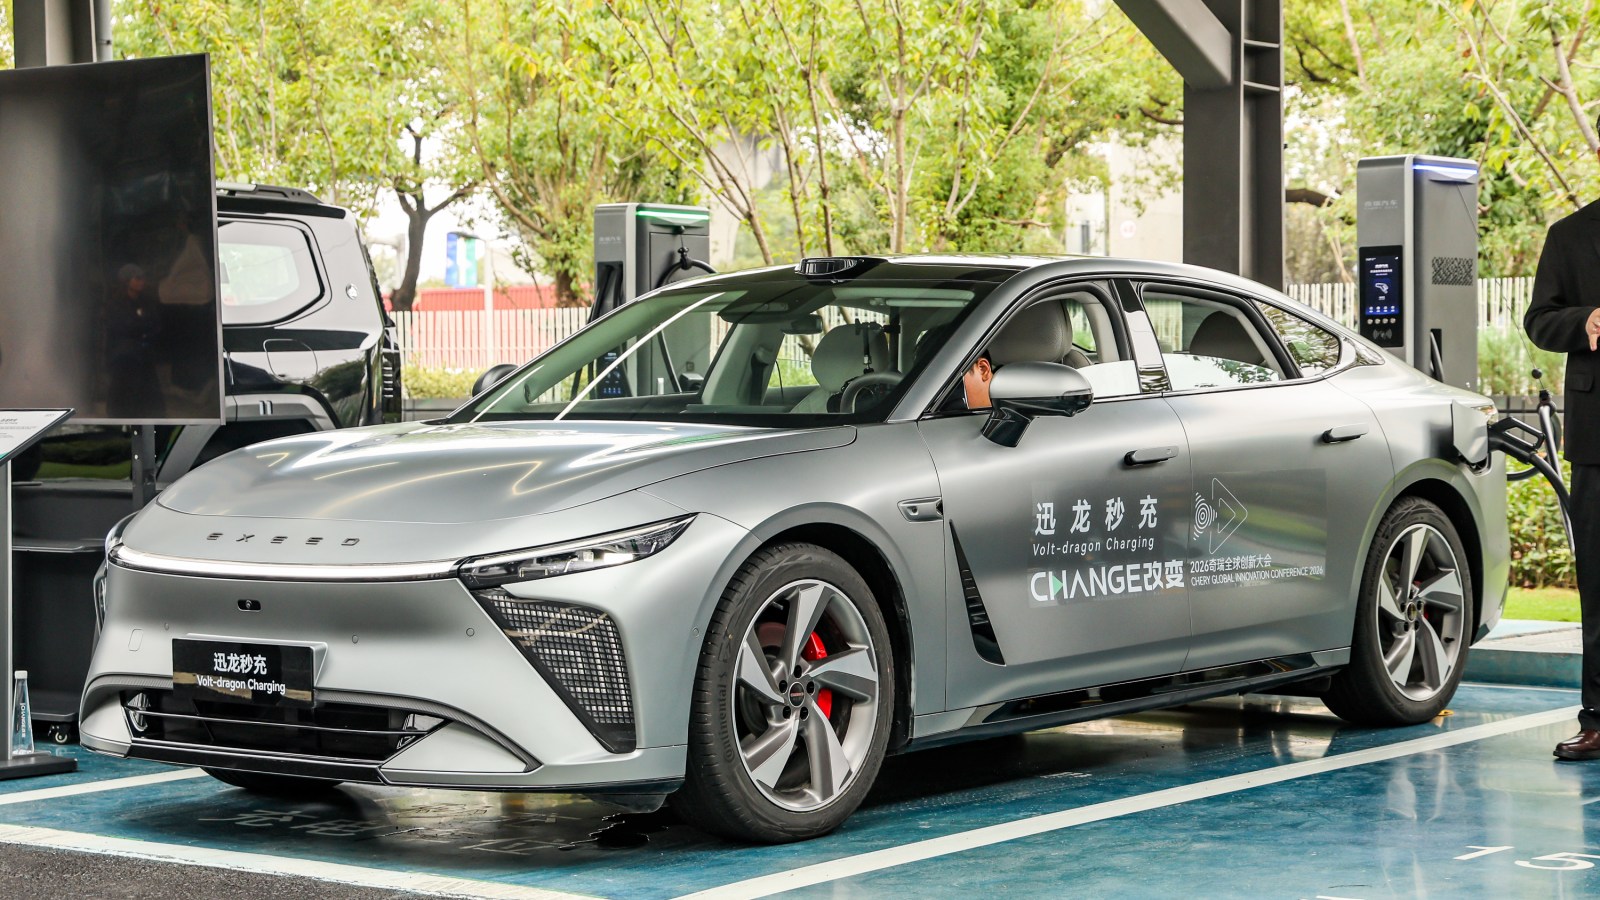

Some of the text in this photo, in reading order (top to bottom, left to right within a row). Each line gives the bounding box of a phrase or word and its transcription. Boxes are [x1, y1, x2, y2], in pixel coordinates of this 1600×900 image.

[1035, 494, 1158, 536] 迅龙秒充
[206, 532, 360, 546] EXEED
[1032, 535, 1154, 556] Volt-dragon Charging
[1190, 553, 1272, 574] 2026奇瑞全球创新大会
[1191, 565, 1324, 587] CHERY GLOBAL INNOVATION CONFERENCE 2026
[213, 652, 268, 675] 迅龙秒充
[196, 674, 287, 696] Volt-dragon Charging
[1453, 845, 1600, 871] 15
